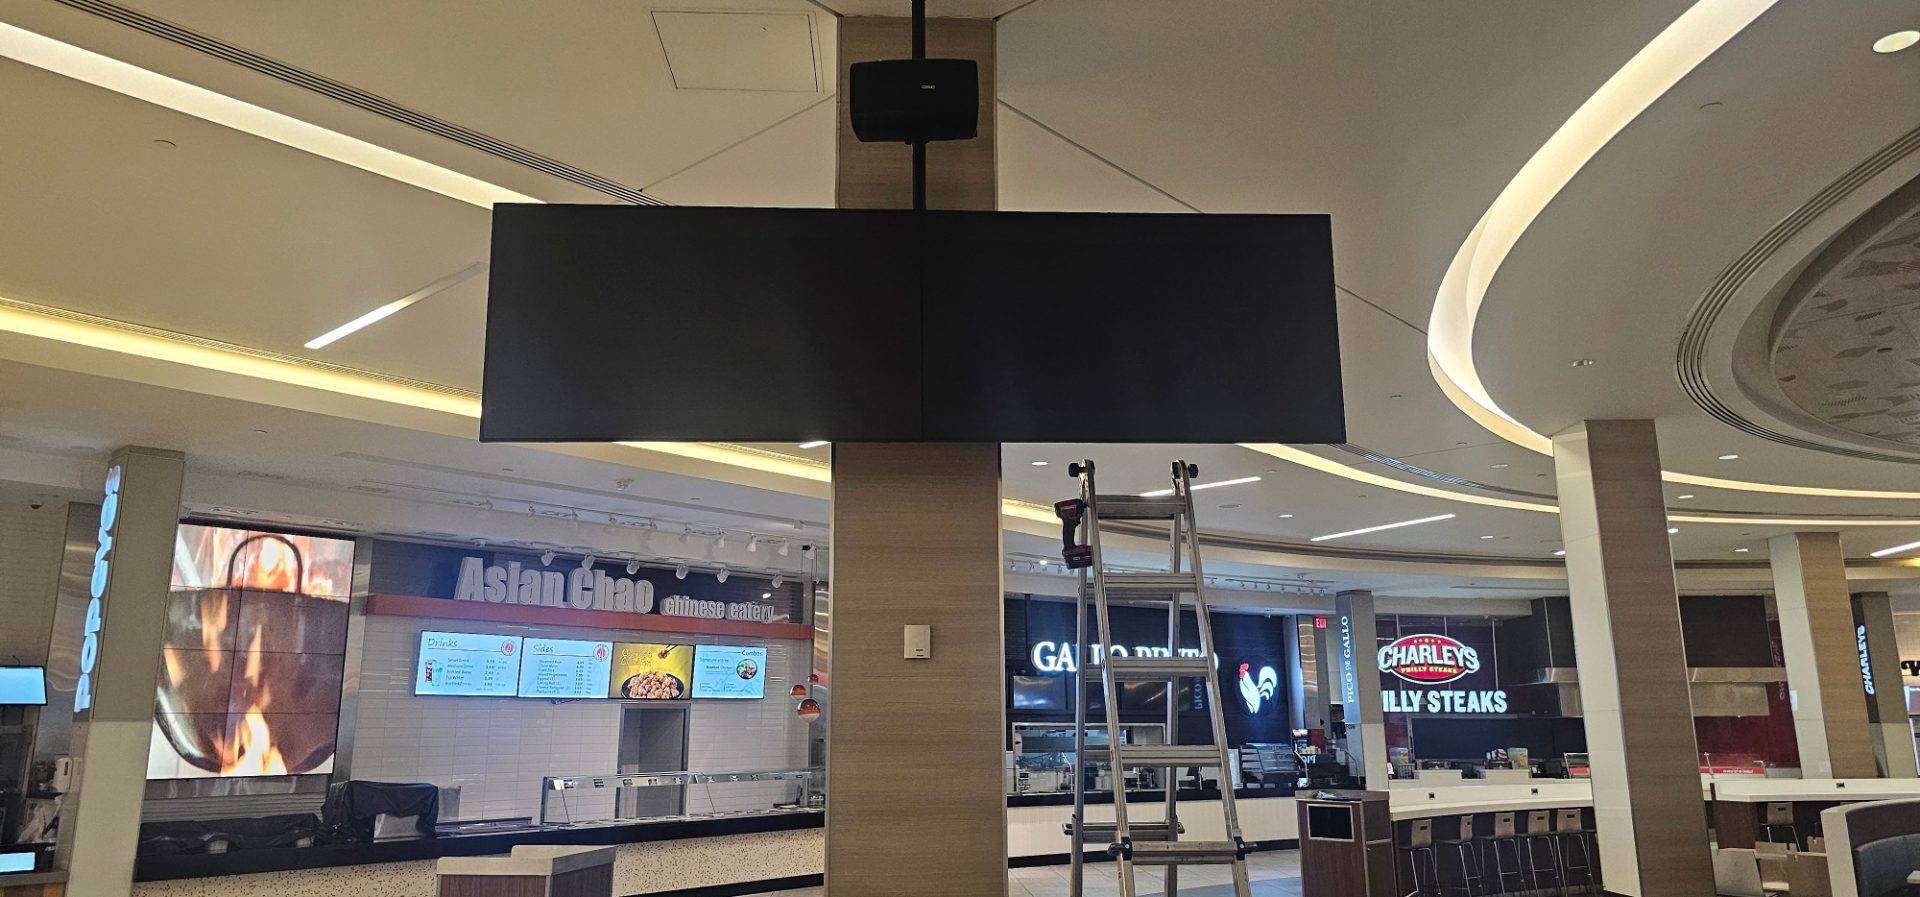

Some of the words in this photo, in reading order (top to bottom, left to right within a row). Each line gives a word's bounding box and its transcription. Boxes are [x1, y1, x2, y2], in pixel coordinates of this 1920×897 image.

[455, 556, 566, 609] Asian
[567, 566, 654, 614] Chao
[660, 594, 726, 620] chinese
[725, 601, 775, 624] eatery
[427, 638, 458, 648] Drinks
[533, 643, 554, 653] Sides
[1341, 616, 1351, 659] GALLO
[1378, 644, 1478, 671] CHARLEYS
[1400, 665, 1428, 673] PHILLY
[1429, 666, 1458, 674] STEAKS
[1857, 625, 1875, 695] CHARLEYS
[1345, 672, 1355, 704] PICO
[1382, 690, 1423, 713] ILLY
[1427, 690, 1507, 713] STEAKS
